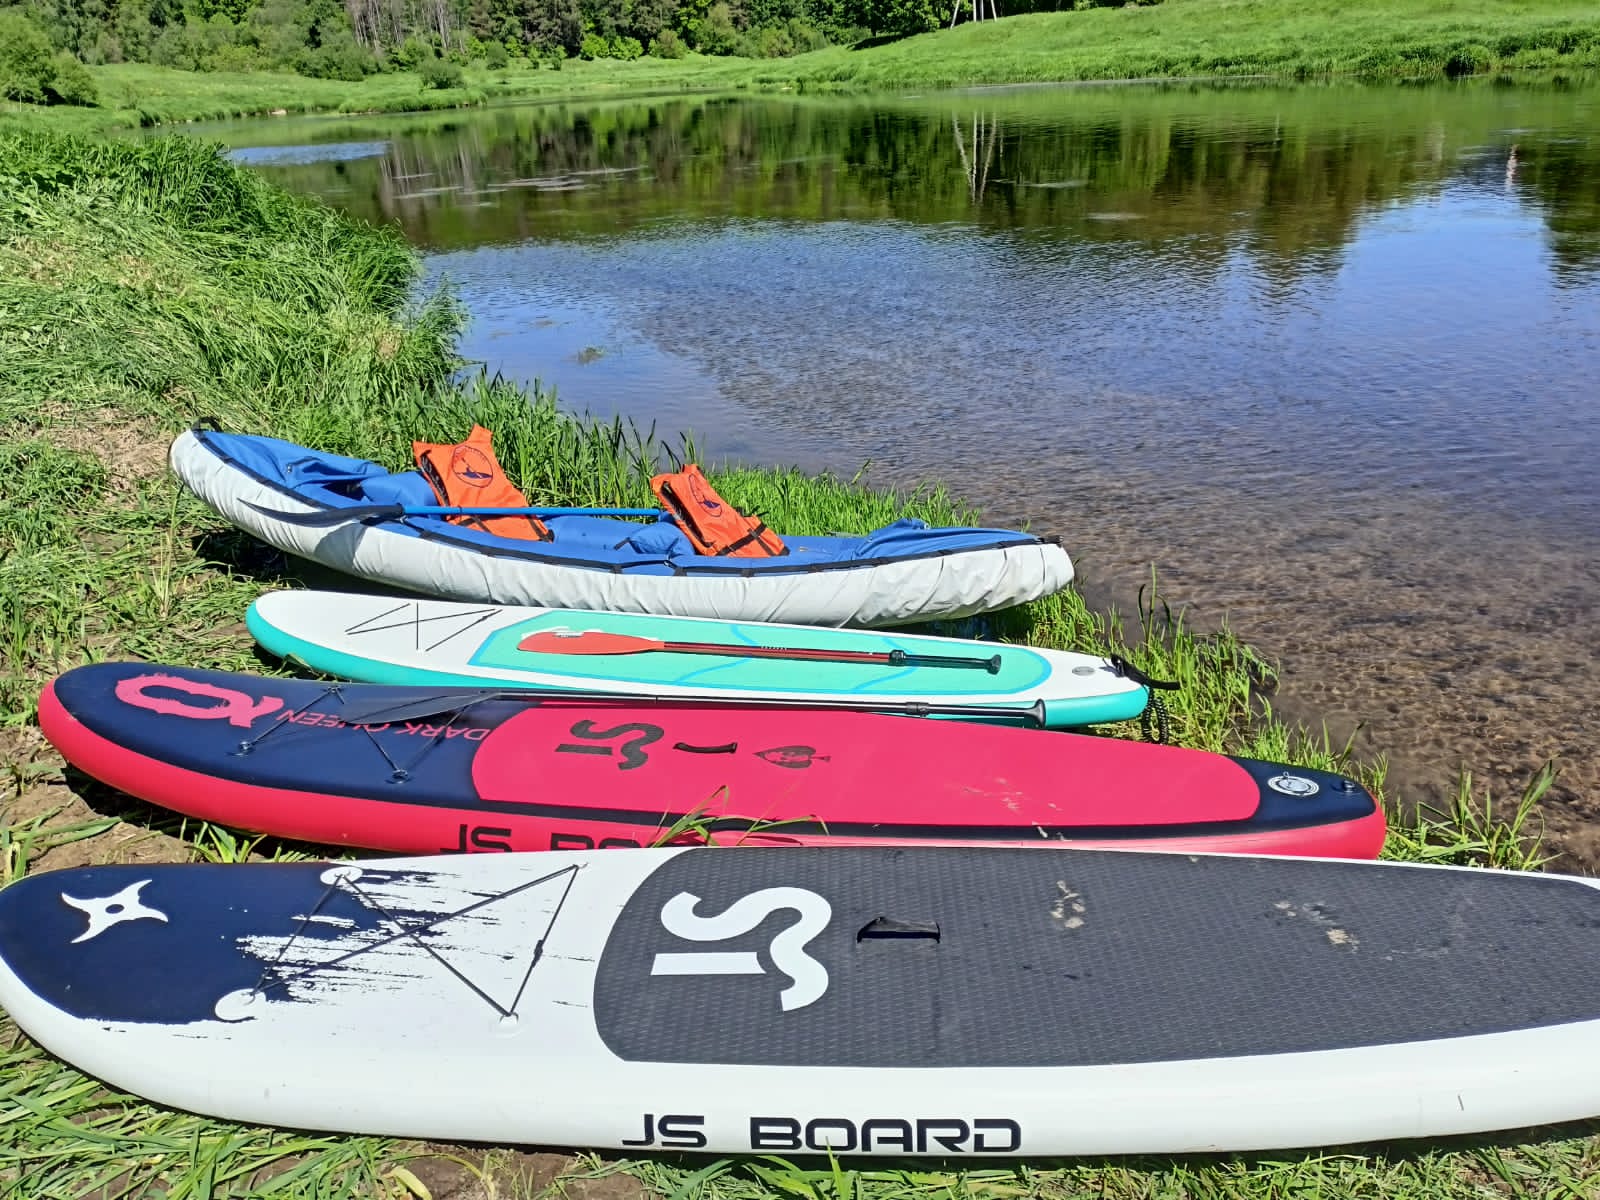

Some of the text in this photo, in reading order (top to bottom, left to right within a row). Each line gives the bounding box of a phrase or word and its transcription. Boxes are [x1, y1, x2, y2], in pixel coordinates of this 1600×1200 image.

[395, 721, 493, 741] DARK
[621, 1113, 1022, 1153] JS BOARD
